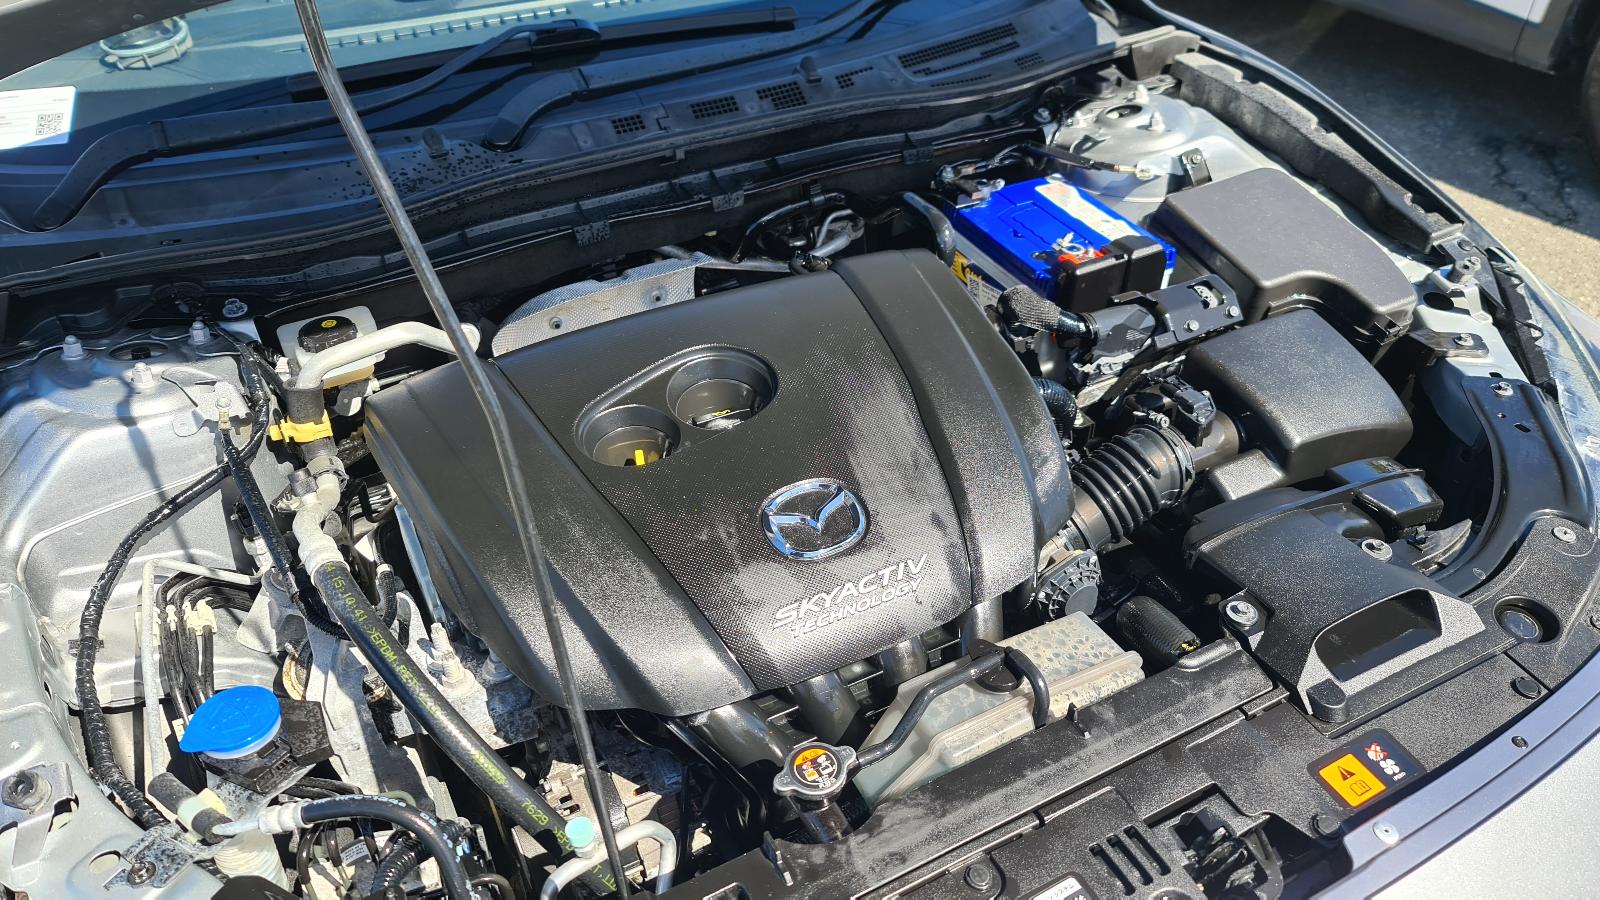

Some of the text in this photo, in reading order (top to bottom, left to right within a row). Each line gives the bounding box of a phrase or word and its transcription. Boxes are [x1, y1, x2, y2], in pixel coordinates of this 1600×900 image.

[773, 553, 928, 630] SKYACTIV
[791, 577, 923, 638] TECHNOLOGY
[521, 797, 549, 826] 7629
